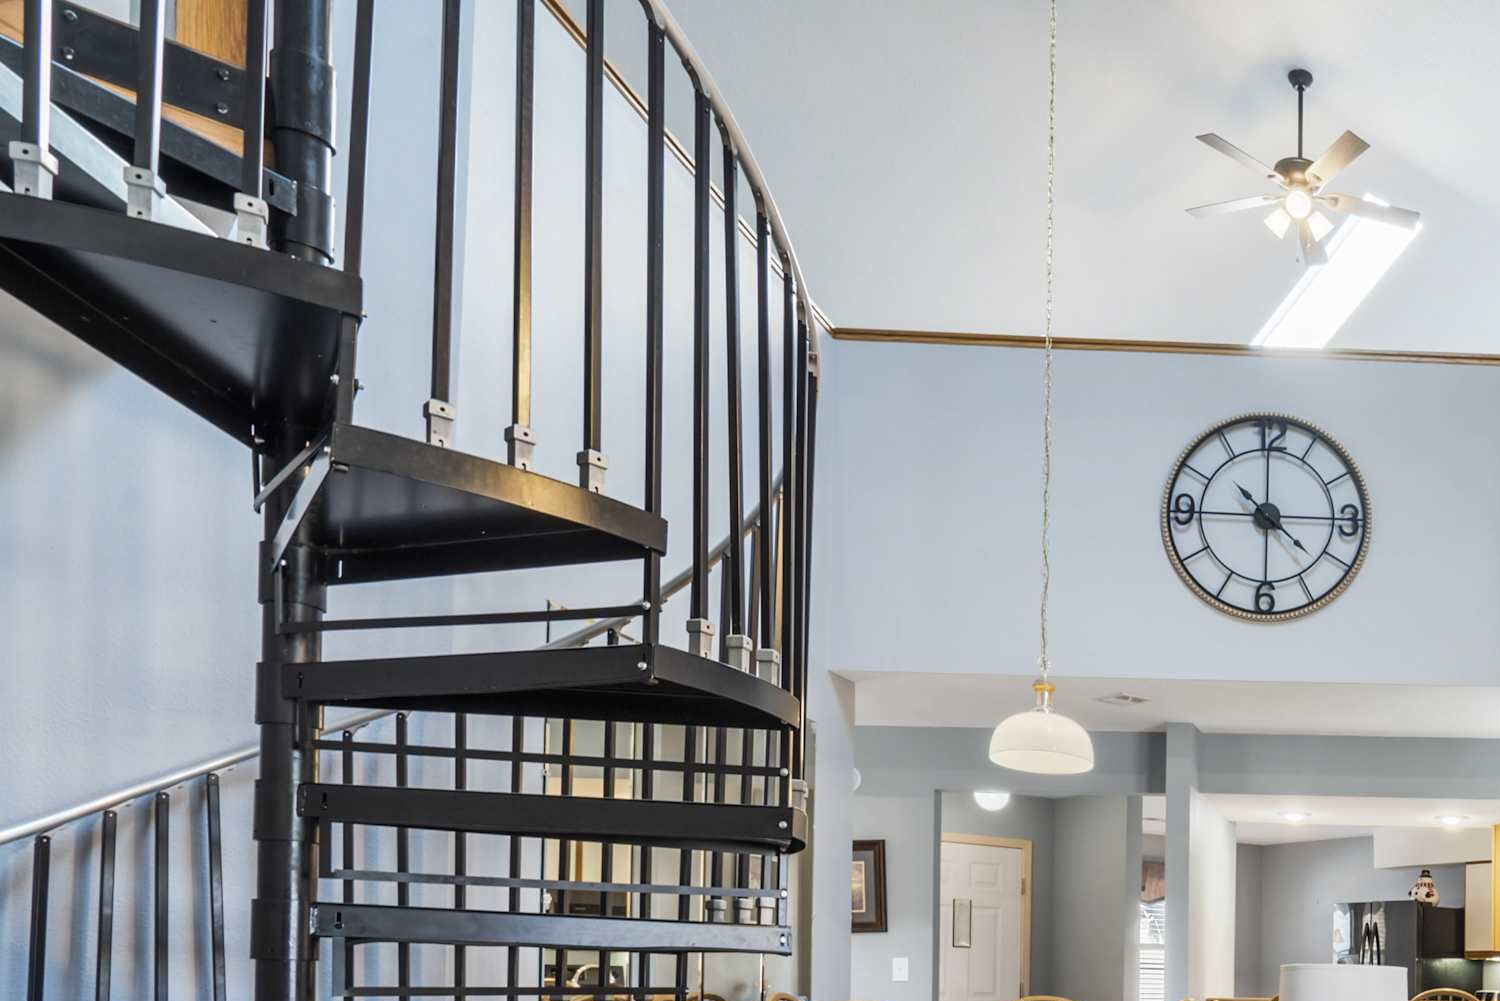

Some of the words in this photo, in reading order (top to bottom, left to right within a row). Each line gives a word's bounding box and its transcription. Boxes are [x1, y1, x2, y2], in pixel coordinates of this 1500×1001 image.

[1252, 419, 1287, 451] 12
[1174, 493, 1196, 526] 9
[1338, 504, 1359, 537] 3
[1254, 582, 1276, 613] 6
